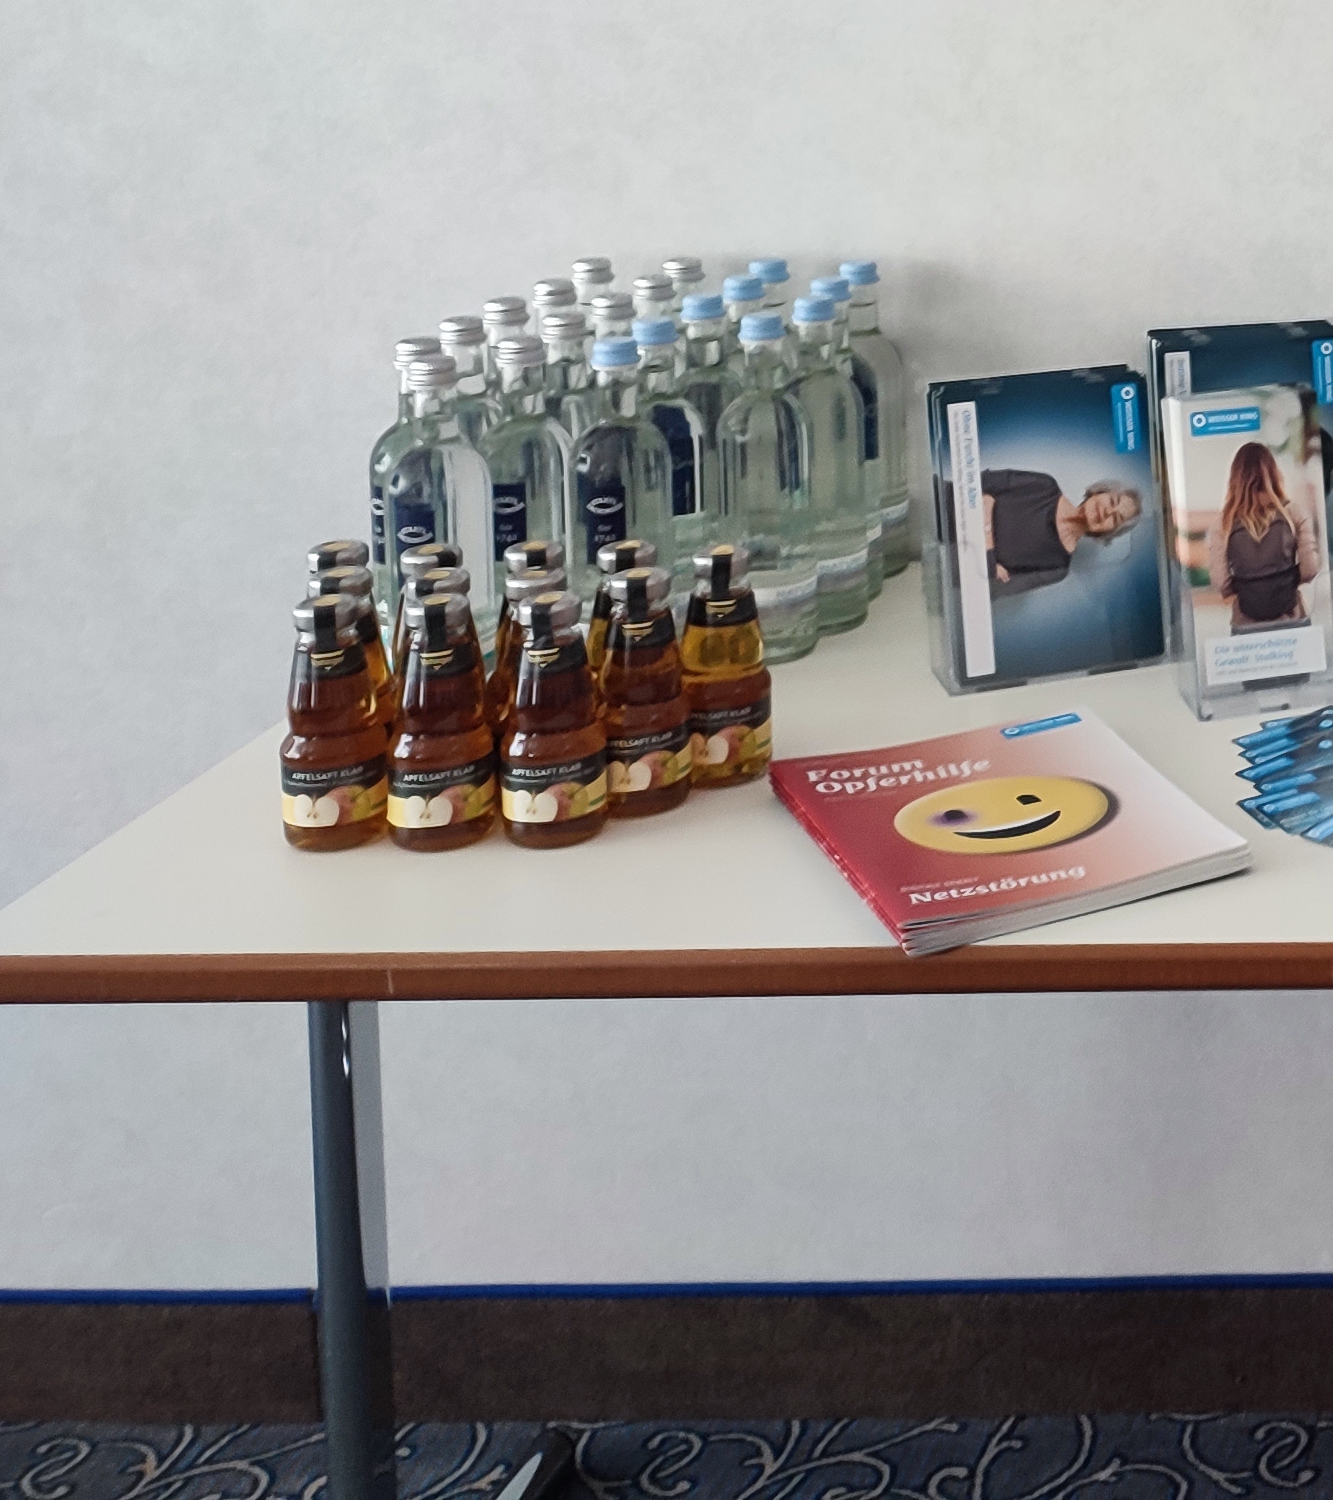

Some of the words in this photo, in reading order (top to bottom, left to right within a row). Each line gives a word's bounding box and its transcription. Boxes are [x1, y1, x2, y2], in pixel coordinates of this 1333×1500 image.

[805, 758, 924, 783] Forum
[815, 758, 992, 795] Opferhilfe
[908, 865, 1087, 905] Netzstörung
